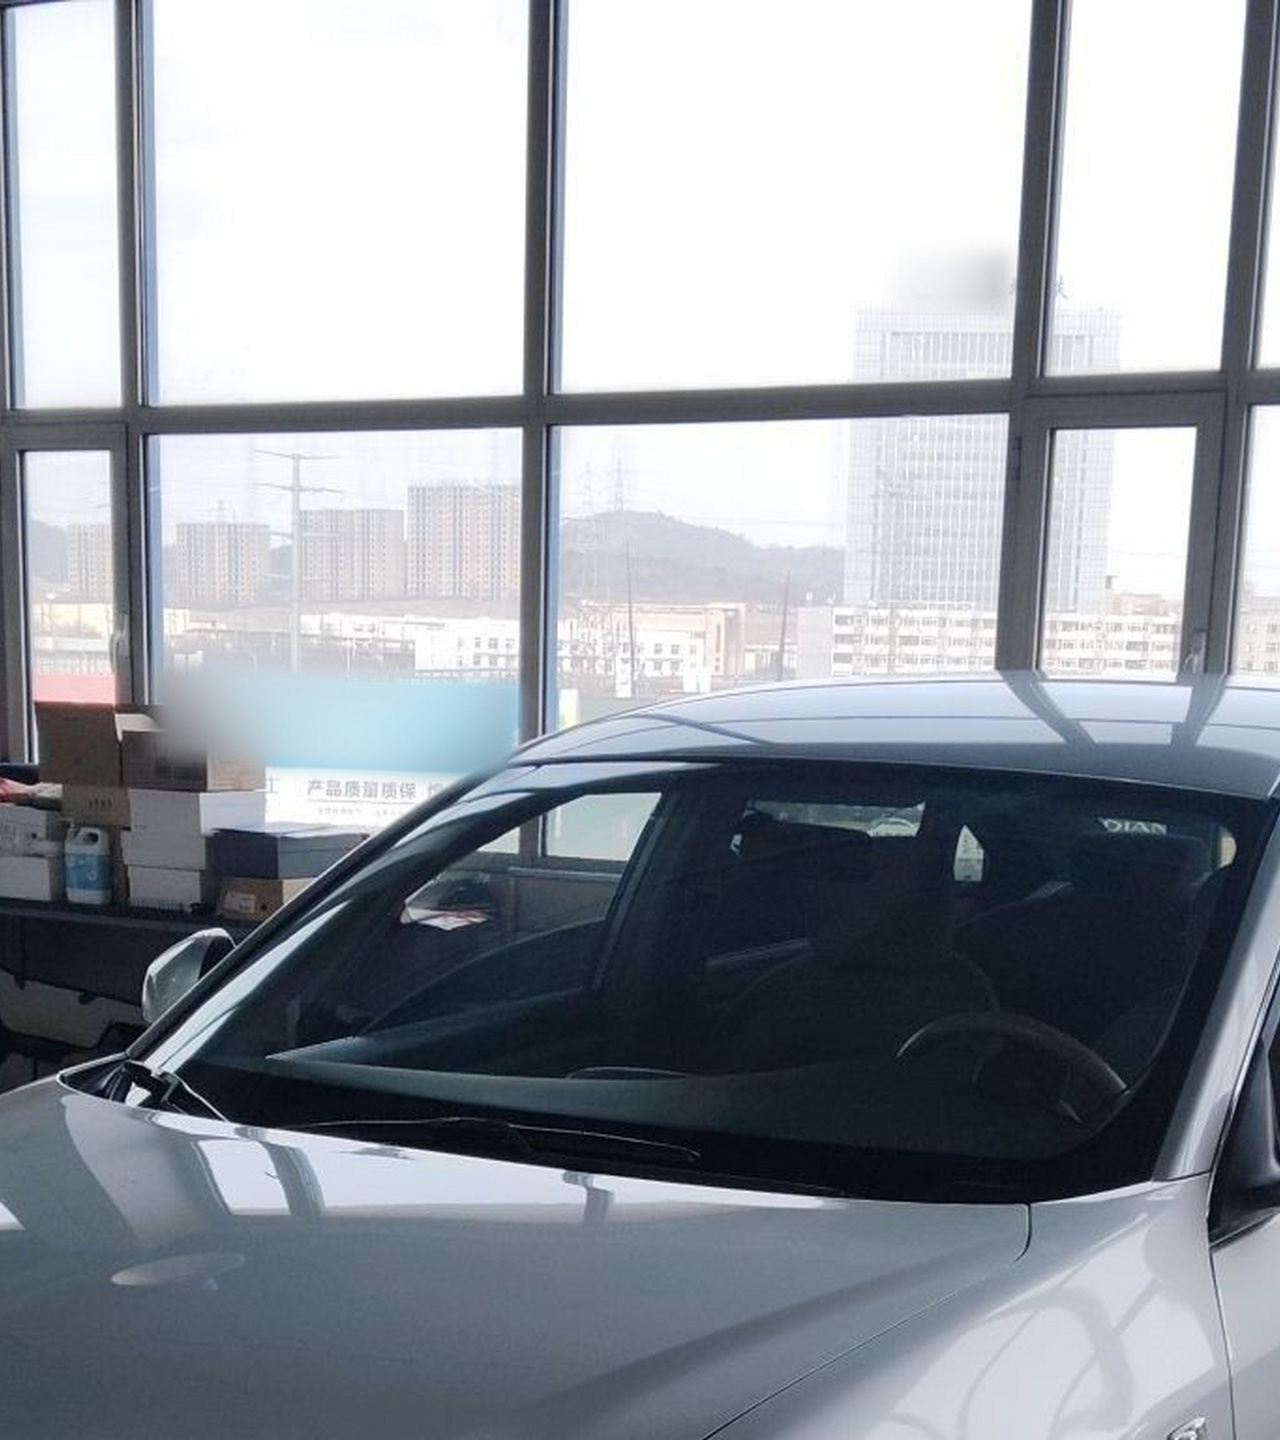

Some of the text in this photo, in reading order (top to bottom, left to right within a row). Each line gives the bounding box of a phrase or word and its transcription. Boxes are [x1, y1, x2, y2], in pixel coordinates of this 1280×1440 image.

[307, 777, 416, 800] 产品质量质保
